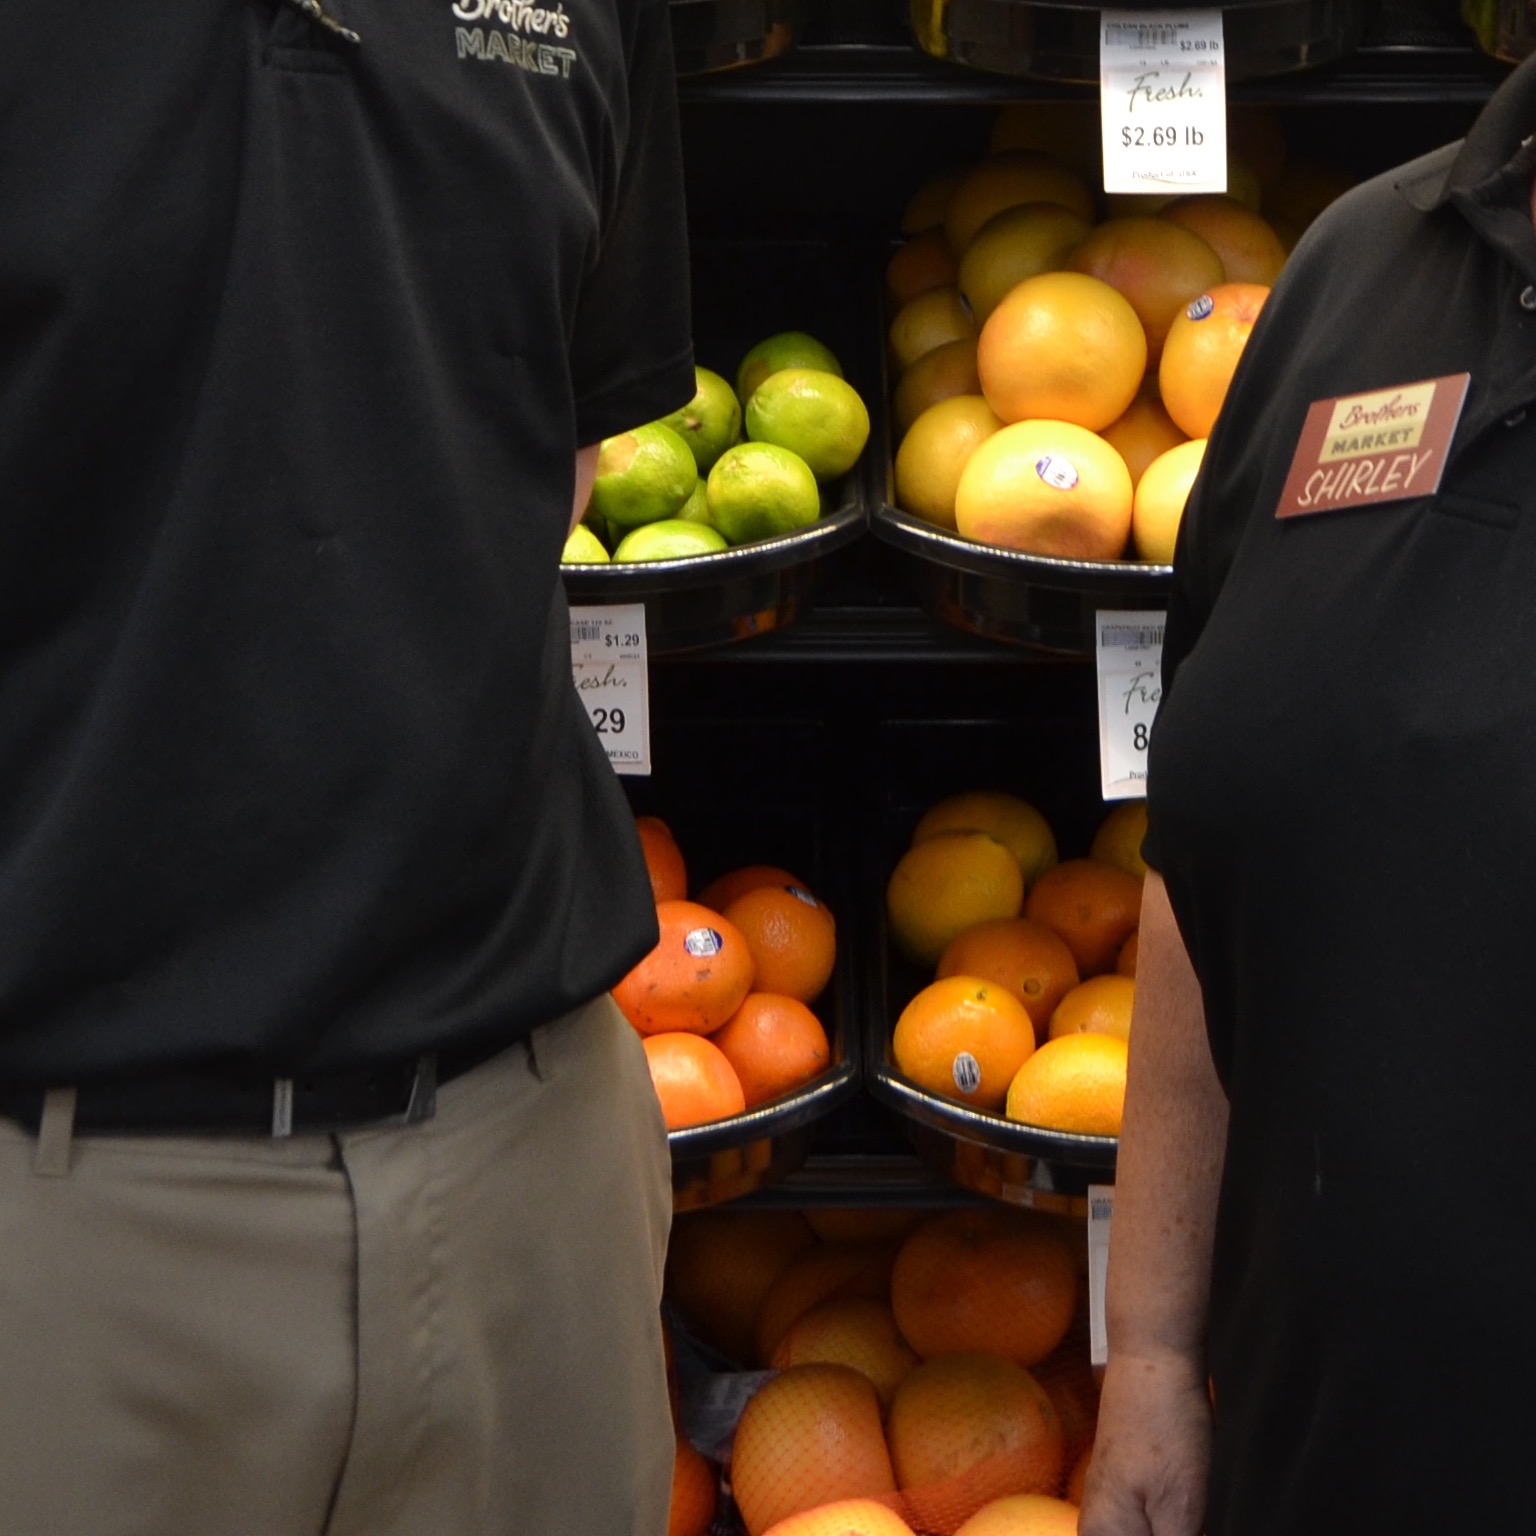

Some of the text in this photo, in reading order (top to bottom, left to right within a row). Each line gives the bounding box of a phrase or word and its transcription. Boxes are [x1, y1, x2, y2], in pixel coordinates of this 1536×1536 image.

[455, 26, 576, 79] MARKET
[1121, 126, 1204, 148] $2.69 lb
[1331, 427, 1414, 454] MARKET
[1297, 448, 1433, 507] SHIRLEY
[605, 633, 640, 648] $1.29
